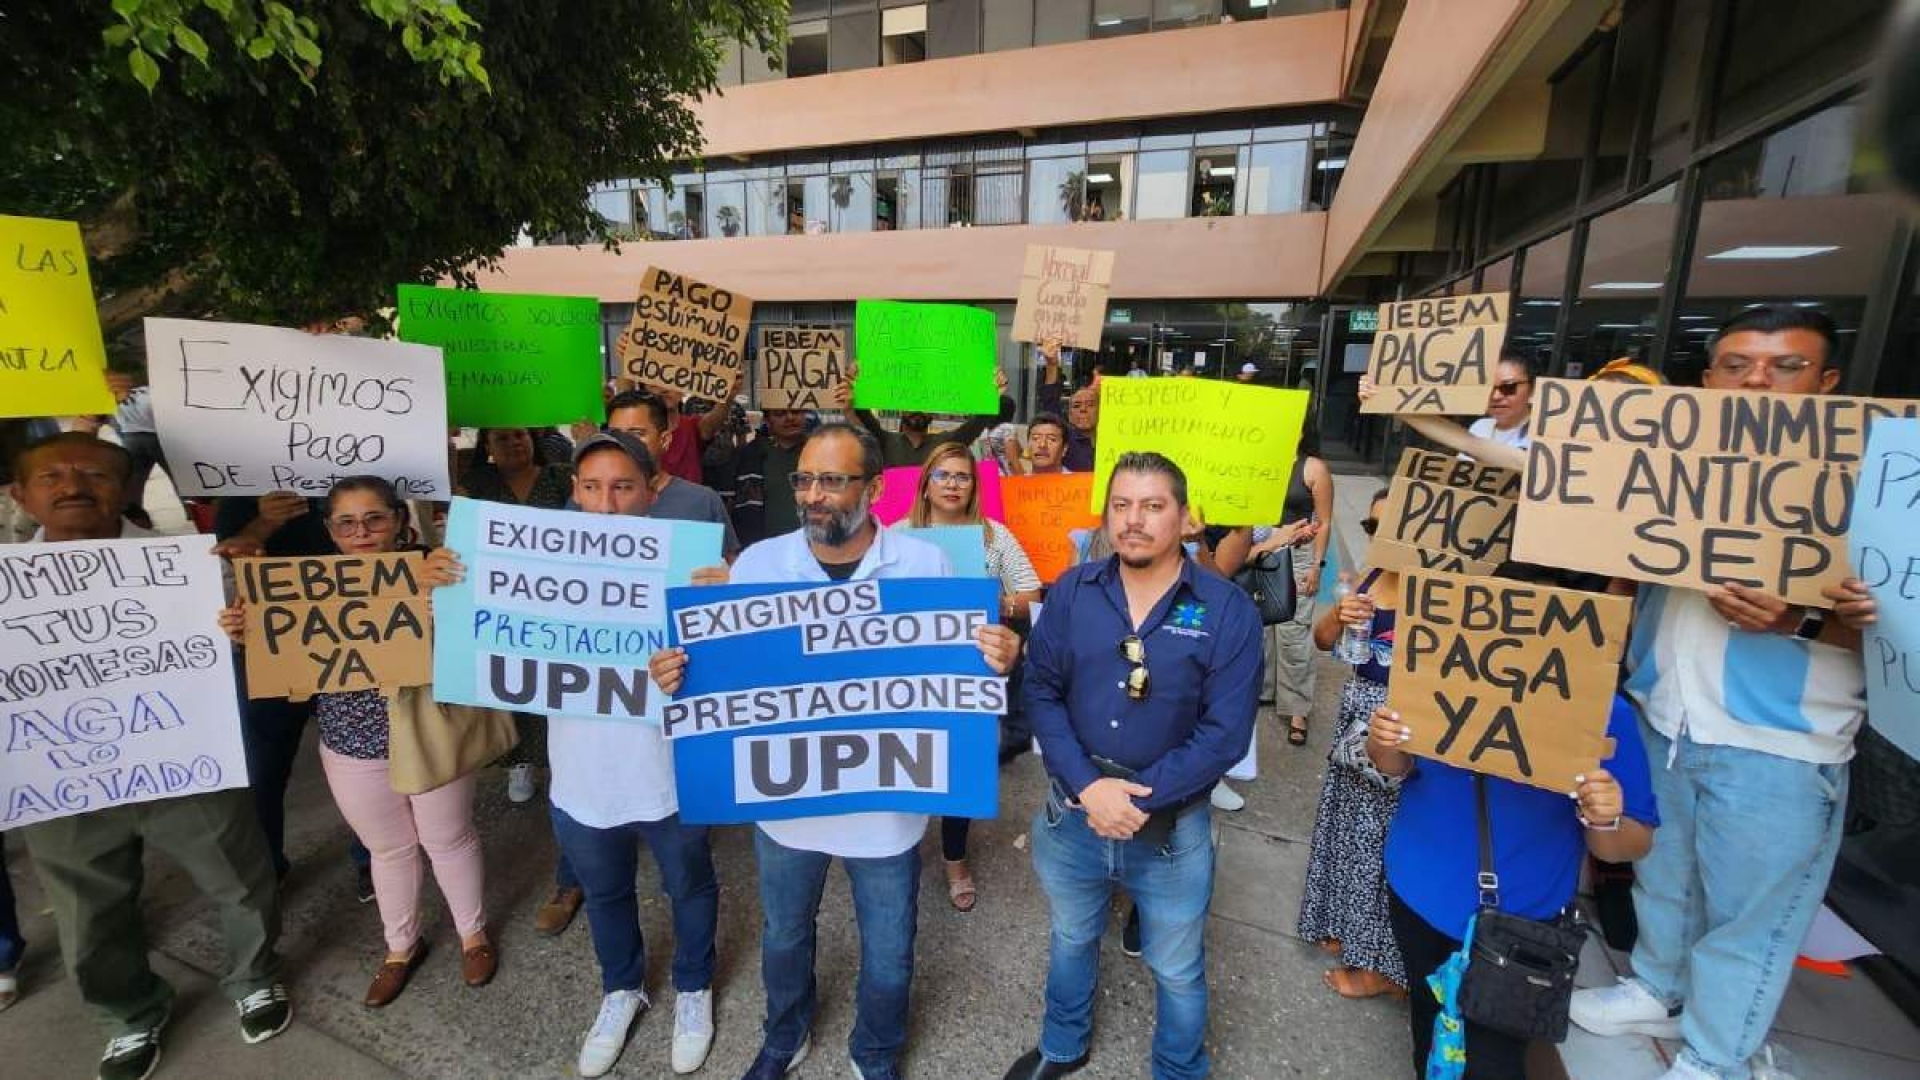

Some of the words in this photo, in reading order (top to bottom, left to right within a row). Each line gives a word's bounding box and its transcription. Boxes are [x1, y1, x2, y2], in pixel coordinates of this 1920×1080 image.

[17, 243, 78, 276] LAS
[409, 297, 510, 324] EXIGIMOS
[655, 269, 732, 312] PAGO
[1388, 296, 1499, 330] IEBEM
[631, 321, 738, 369] desempeño
[764, 329, 841, 349] IEBEM
[1375, 327, 1486, 385] PAGA
[179, 338, 413, 421] Exigimos
[448, 369, 540, 388] EMANDAS
[627, 349, 729, 398] docente
[765, 348, 841, 390] PAGA
[786, 390, 820, 409] YA
[1106, 385, 1196, 406] RESPETO
[1220, 391, 1232, 409] Y
[1396, 387, 1446, 412] YA
[289, 422, 385, 467] Pago
[1117, 416, 1267, 444] CUMPLIMIENTO
[1538, 381, 1701, 451] PAGO
[1720, 395, 1917, 463] INME
[193, 461, 257, 489] DE
[271, 465, 436, 494] Prestnes
[1527, 442, 1594, 504] DE
[488, 520, 660, 560] EXIGIMOS
[1397, 481, 1518, 561] PAGA
[1628, 519, 1831, 597] SEP
[243, 559, 419, 604] IEBEM
[489, 570, 589, 605] PAGO
[601, 581, 649, 609] DE
[3, 599, 157, 645] TUS
[264, 601, 424, 655] PAGA
[679, 584, 877, 641] EXIGIMOS
[805, 615, 920, 653] PAGO
[934, 613, 984, 642] DE
[1406, 575, 1605, 648] IEBEM
[308, 648, 376, 691] YA
[489, 655, 648, 717] UPN
[1406, 625, 1571, 703] PAGA
[7, 690, 185, 754] AGA
[662, 677, 1004, 737] PRESTACIONES
[1434, 691, 1532, 777] YA
[48, 743, 120, 771] LO
[750, 732, 934, 797] UPN
[3, 754, 223, 822] ACTADO
